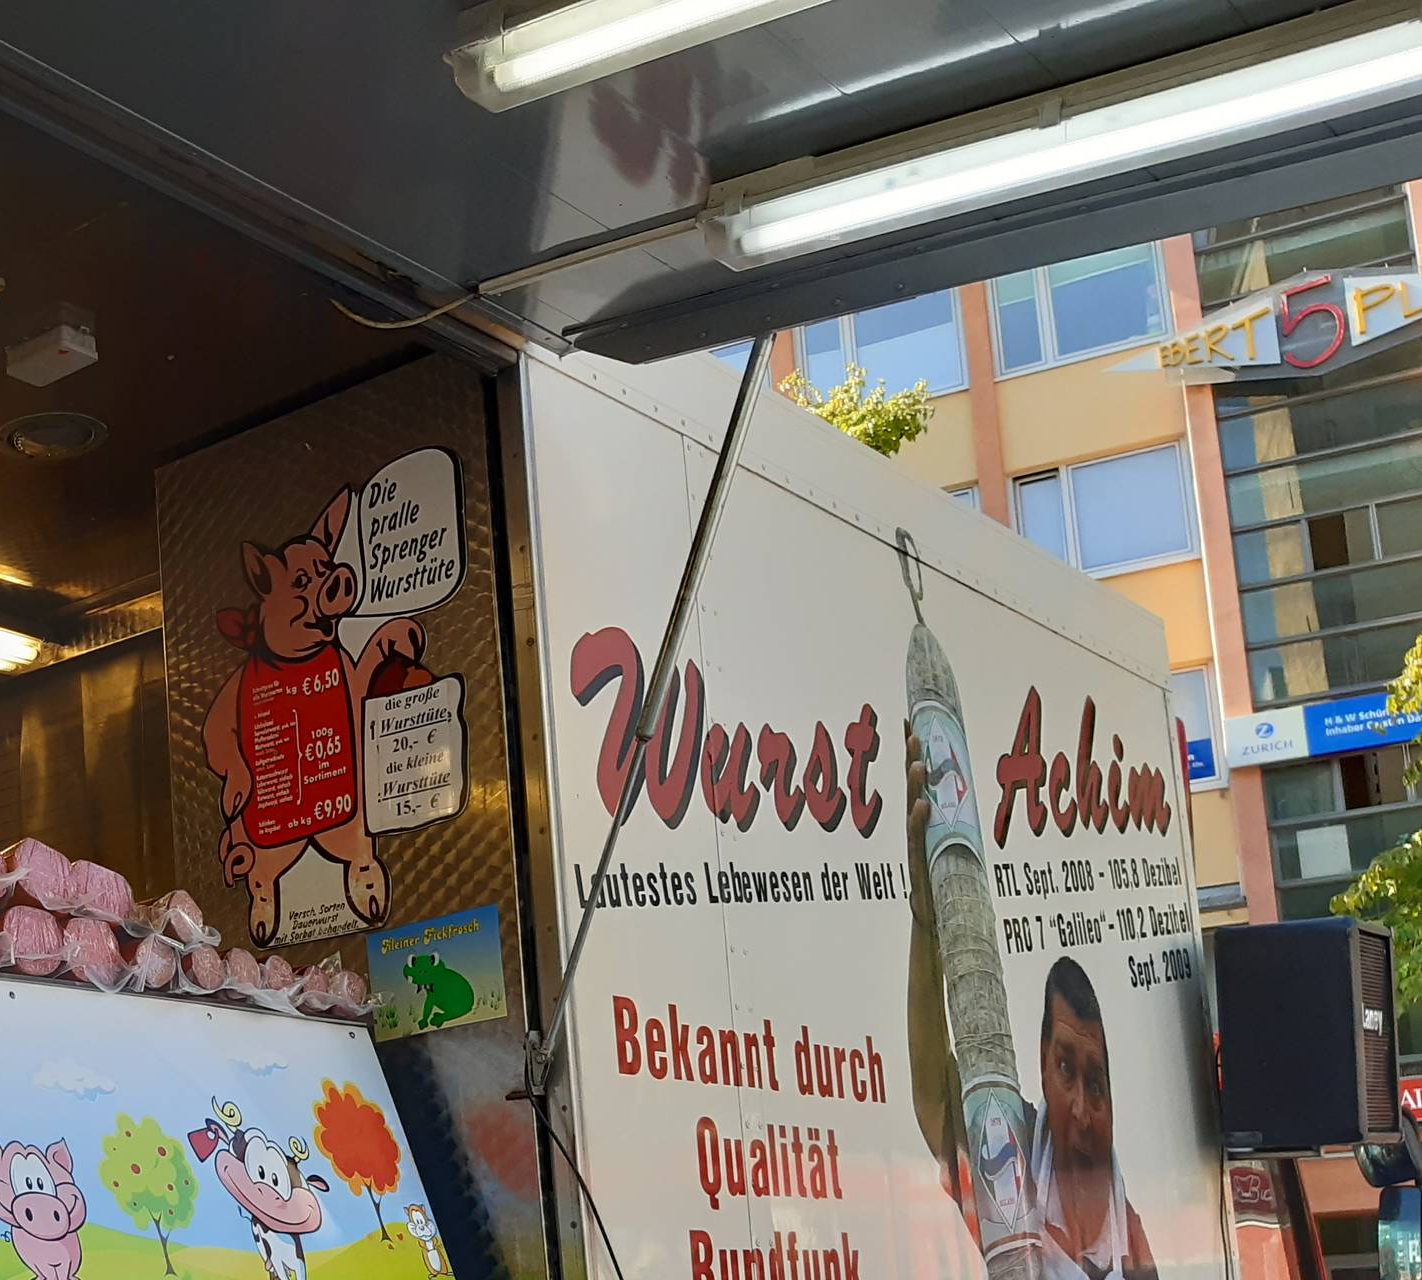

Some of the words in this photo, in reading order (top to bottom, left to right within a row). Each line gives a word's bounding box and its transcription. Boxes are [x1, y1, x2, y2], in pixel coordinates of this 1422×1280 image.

[1280, 274, 1345, 369] 5
[369, 478, 396, 509] Die
[369, 500, 419, 544] pralle
[370, 527, 447, 573] Sprenger
[371, 557, 454, 603] Wursttüte
[286, 686, 297, 696] kg
[385, 699, 402, 711] die
[404, 687, 439, 709] große
[380, 707, 447, 734] Wursttüte
[571, 626, 883, 839] Wurst
[1325, 723, 1364, 736] Inhaber
[311, 727, 334, 740] 100g
[427, 728, 437, 743] €
[305, 735, 341, 761] €0,65
[1242, 740, 1294, 756] ZURICH
[303, 766, 347, 785] Sortiment
[318, 760, 329, 770] im
[386, 761, 403, 775] die
[406, 751, 444, 770] kleine
[383, 772, 451, 797] Wursttüte
[430, 793, 440, 808] €
[288, 818, 298, 829] ab
[300, 815, 312, 826] kg
[703, 861, 815, 904] Lebewesen
[821, 862, 848, 902] der
[855, 863, 896, 900] Welt
[994, 862, 1021, 897] RTL
[1024, 862, 1059, 899] Sept.
[1062, 860, 1094, 892] 2008
[1108, 859, 1140, 891] 105,8
[1142, 857, 1182, 888] Dezibel
[320, 902, 346, 915] Sorten
[292, 913, 338, 930] Dauerwurst
[1004, 918, 1033, 953] PRO
[1036, 916, 1045, 949] 7
[1116, 907, 1147, 941] 110,2
[1151, 902, 1191, 936] Dezibel
[289, 929, 316, 940] Sorbat
[1129, 952, 1161, 991] Sept.
[1162, 947, 1192, 983] 2009
[613, 995, 779, 1092] Bekannt
[794, 1025, 886, 1104] durch
[696, 1116, 843, 1210] Qualität
[689, 1229, 861, 1280] Rundfunk
